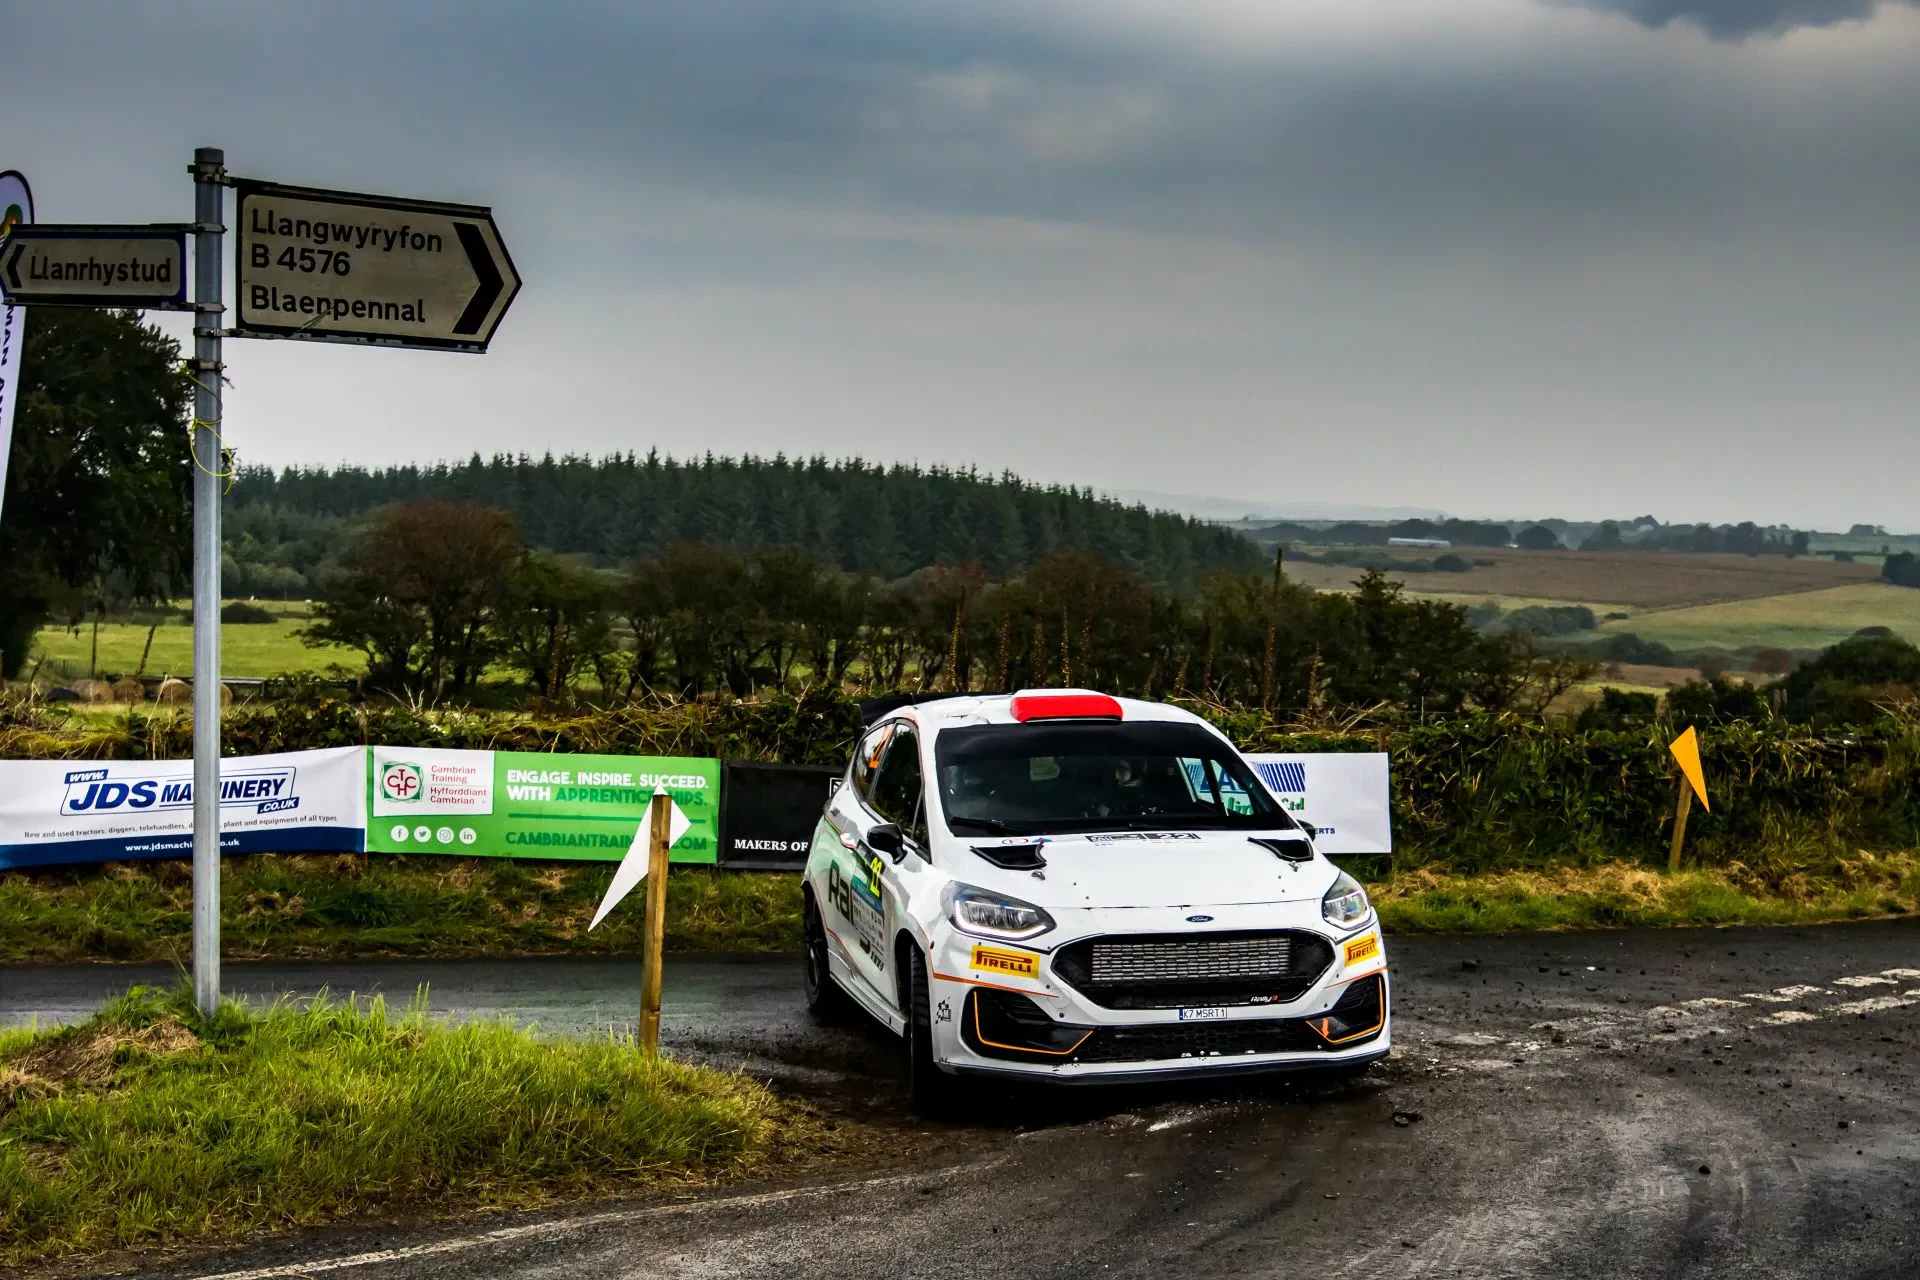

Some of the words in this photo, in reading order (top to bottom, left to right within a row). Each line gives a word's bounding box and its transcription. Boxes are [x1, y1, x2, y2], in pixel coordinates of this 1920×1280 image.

[252, 207, 442, 253] Llangwyryfon
[251, 243, 270, 268] B
[277, 246, 350, 276] 4576
[30, 256, 171, 286] Llanrhystud
[251, 284, 426, 323] Blaenpennal
[431, 765, 476, 775] Cambrian
[431, 774, 468, 784] Training
[507, 769, 574, 785] ENGAGE.
[578, 773, 635, 787] INSPIRE.
[639, 774, 709, 789] SUCCEED.
[69, 780, 158, 811] JDS
[160, 778, 287, 803] MAINERY
[430, 786, 487, 797] Hyfforddiant
[430, 795, 475, 805] Cambrian
[506, 785, 550, 801] WITH
[260, 798, 297, 812] .CO.UK
[24, 831, 40, 839] New
[42, 830, 56, 838] and
[57, 829, 75, 837] used
[76, 828, 106, 836] tractors,
[108, 826, 138, 835] diggers,
[139, 823, 188, 832] telehandlers,
[223, 820, 242, 829] plant
[244, 818, 258, 826] and
[259, 816, 298, 826] equipment
[318, 815, 338, 823] types
[125, 838, 240, 852] www.jdsmachio.uk
[734, 838, 787, 852] MAKERS
[791, 841, 808, 852] OF
[1347, 937, 1376, 961] PIRELLI
[975, 950, 1033, 973] PIRELLI
